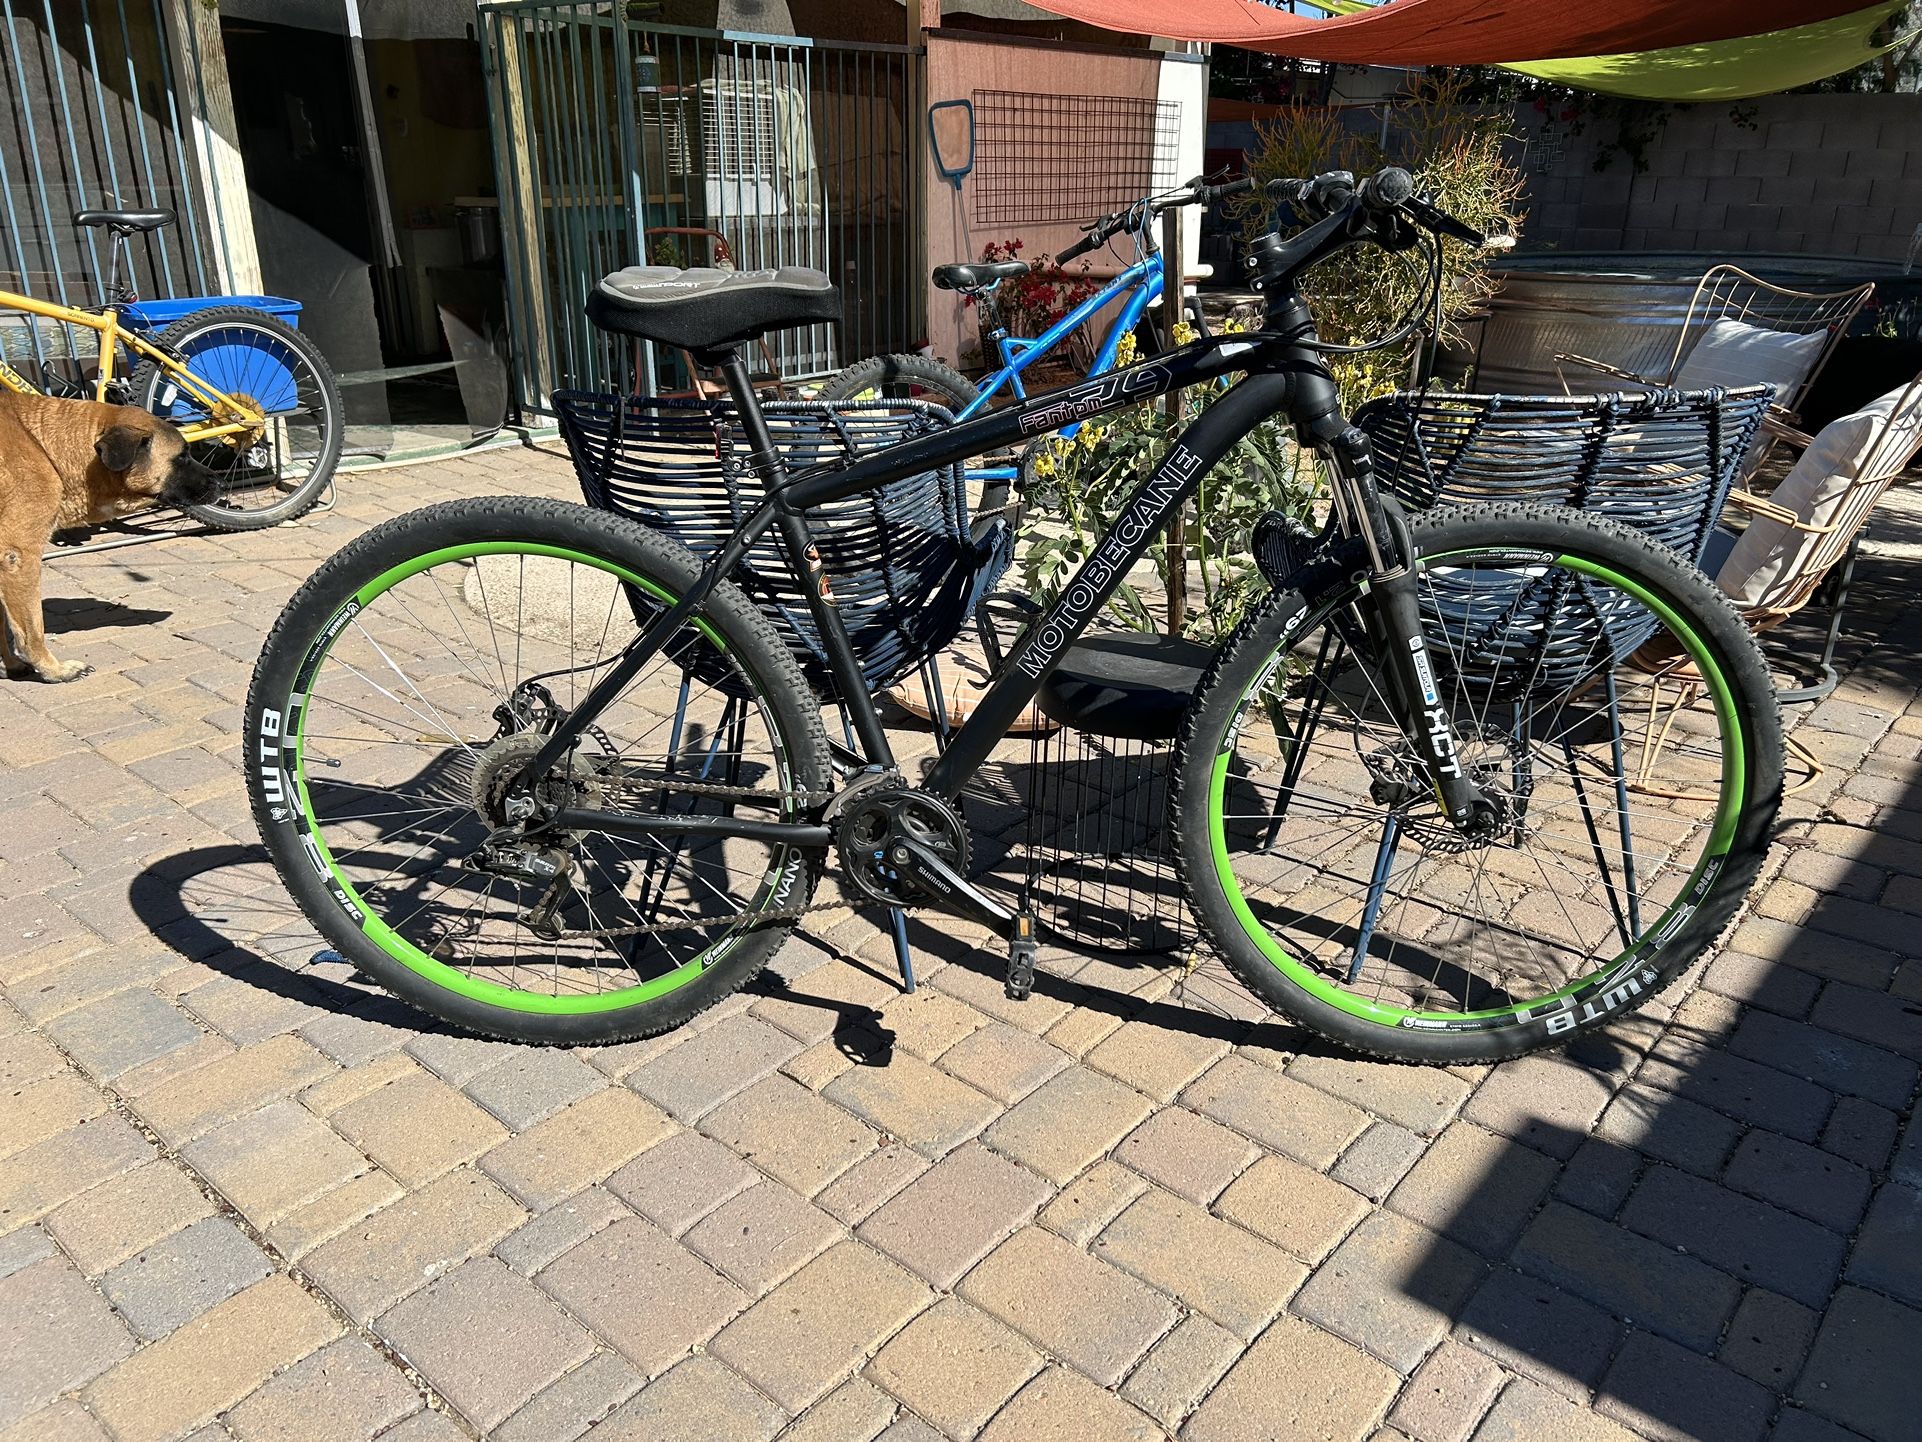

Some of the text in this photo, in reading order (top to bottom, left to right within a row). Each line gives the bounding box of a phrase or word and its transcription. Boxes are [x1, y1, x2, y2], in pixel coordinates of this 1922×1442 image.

[1016, 444, 1202, 679] MOTOBECANE
[261, 707, 284, 802] WTB
[1424, 708, 1462, 779] XCT
[334, 890, 363, 920] DISC
[773, 847, 803, 907] NANO
[917, 866, 951, 893] SHIMANO
[1694, 858, 1720, 895] DISC
[1545, 977, 1643, 1035] WTB
